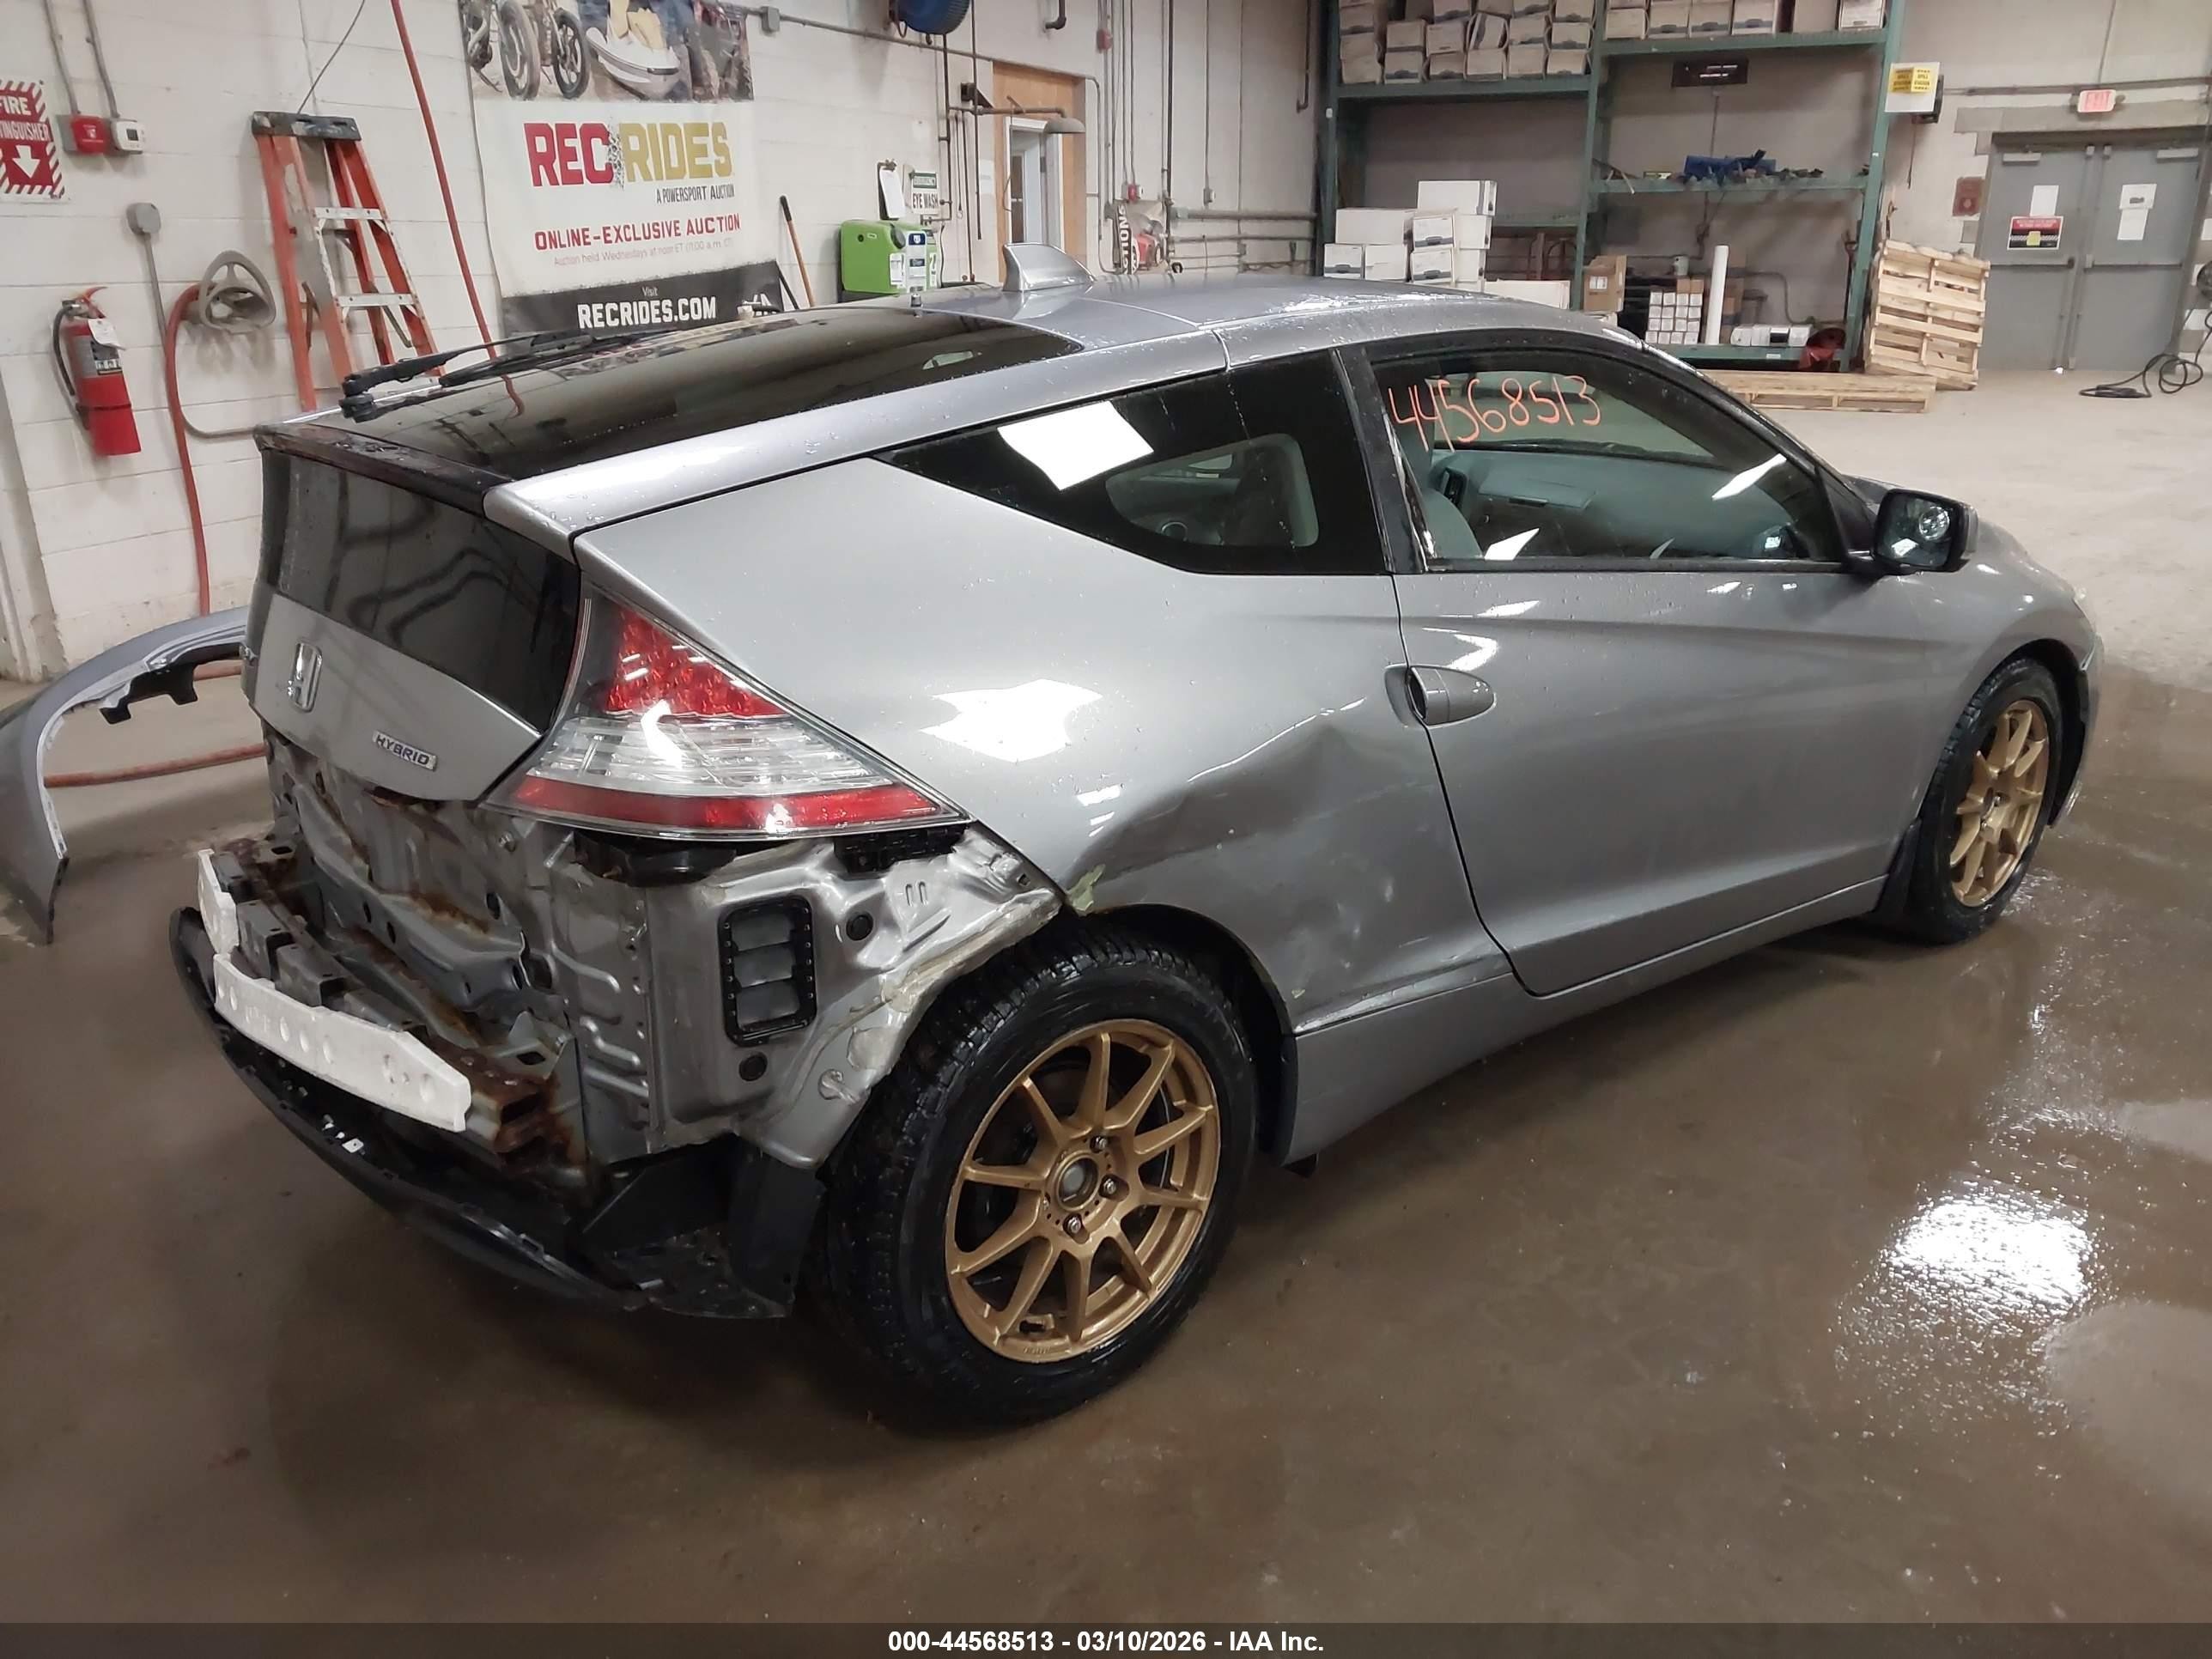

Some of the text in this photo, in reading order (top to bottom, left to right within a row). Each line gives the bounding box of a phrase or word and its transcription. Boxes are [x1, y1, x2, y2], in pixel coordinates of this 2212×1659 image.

[523, 122, 732, 186] REC RIDES
[656, 183, 735, 204] A POWERSPORT AUCTION
[913, 192, 939, 209] EYE WASH
[534, 213, 740, 251] ONLINE-EXCLUSIVE AUCTION
[581, 252, 599, 264] held
[674, 242, 684, 253] ET
[641, 286, 659, 297] Visit
[577, 296, 717, 330] RECRIDES.COM
[1389, 375, 1601, 453] 44568513
[376, 734, 429, 765] HYBRID
